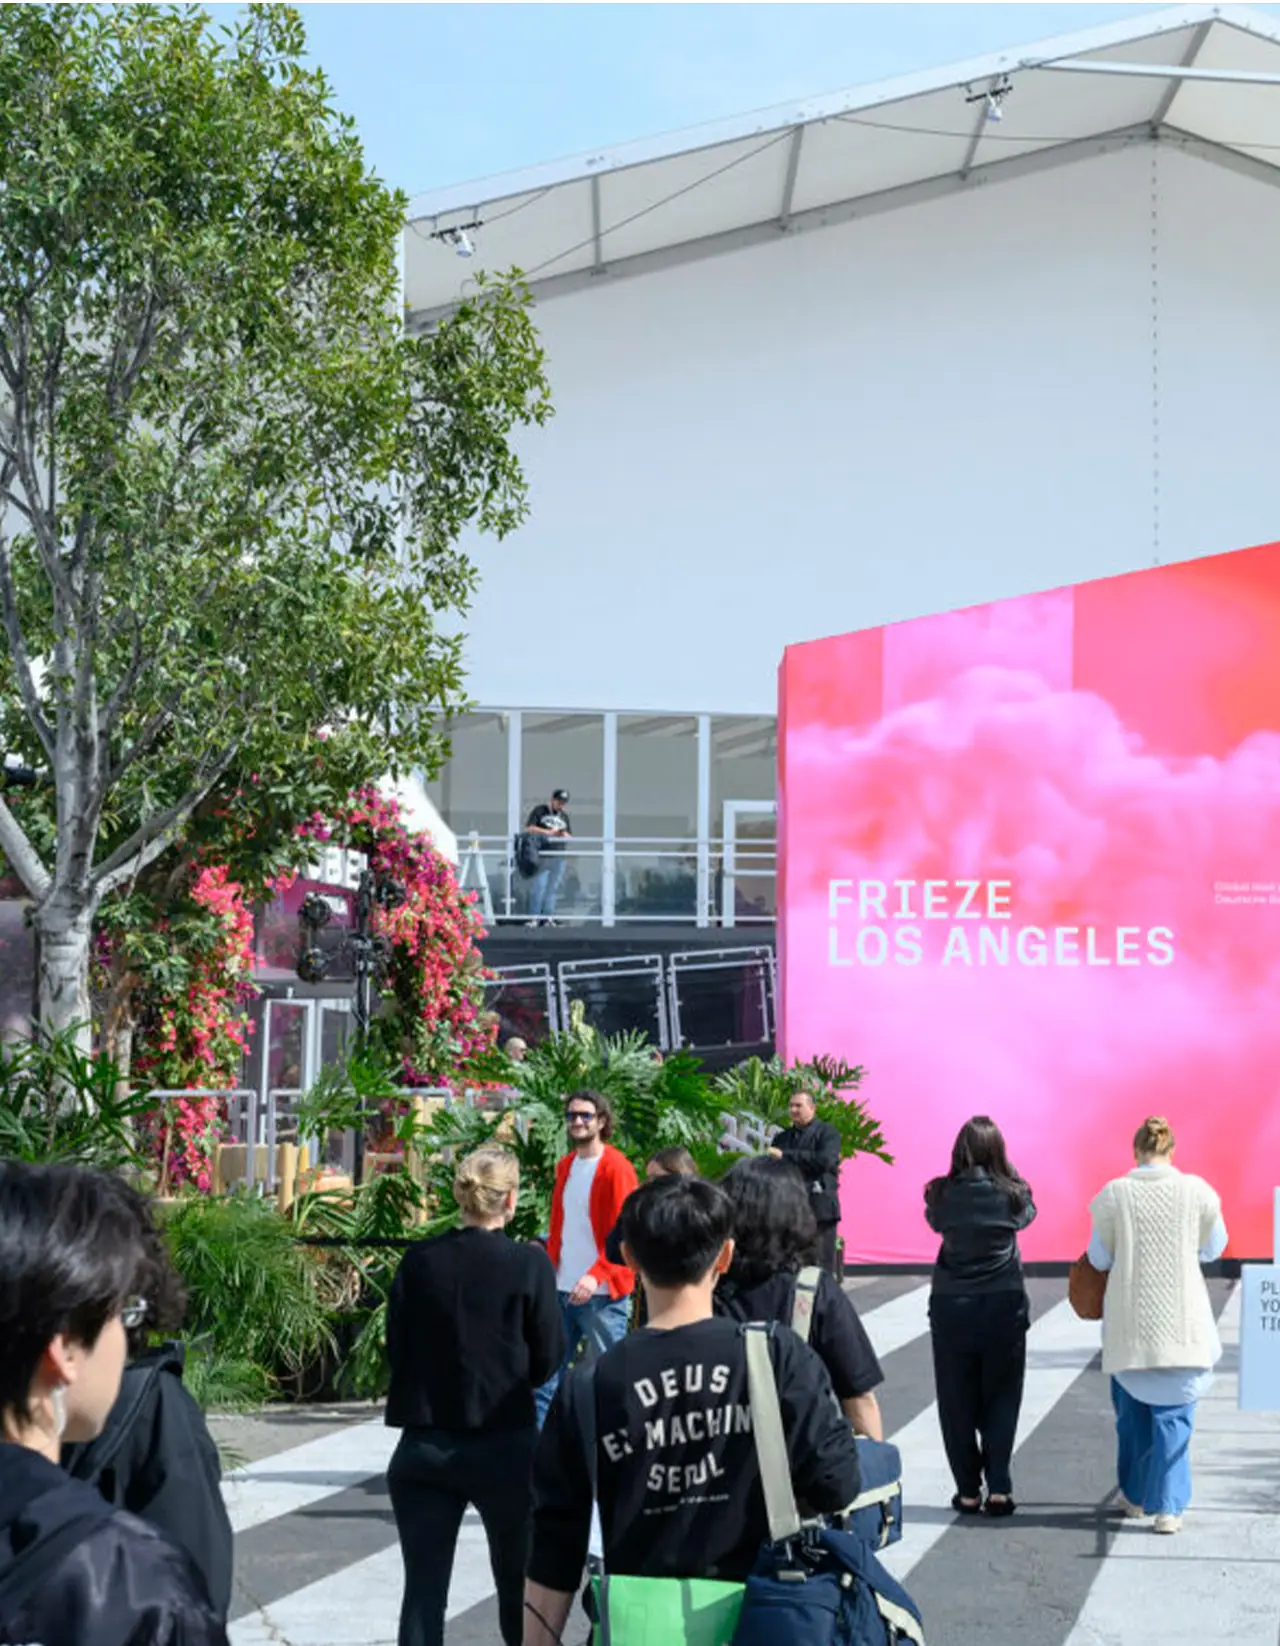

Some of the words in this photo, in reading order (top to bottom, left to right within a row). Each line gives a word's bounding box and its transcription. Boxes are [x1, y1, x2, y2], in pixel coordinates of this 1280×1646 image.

[828, 880, 1012, 920] FRIEZE
[828, 926, 923, 966] LOS
[941, 926, 1175, 966] ANGELES
[634, 1364, 731, 1407] DEUS
[644, 1404, 752, 1450] MACHIN
